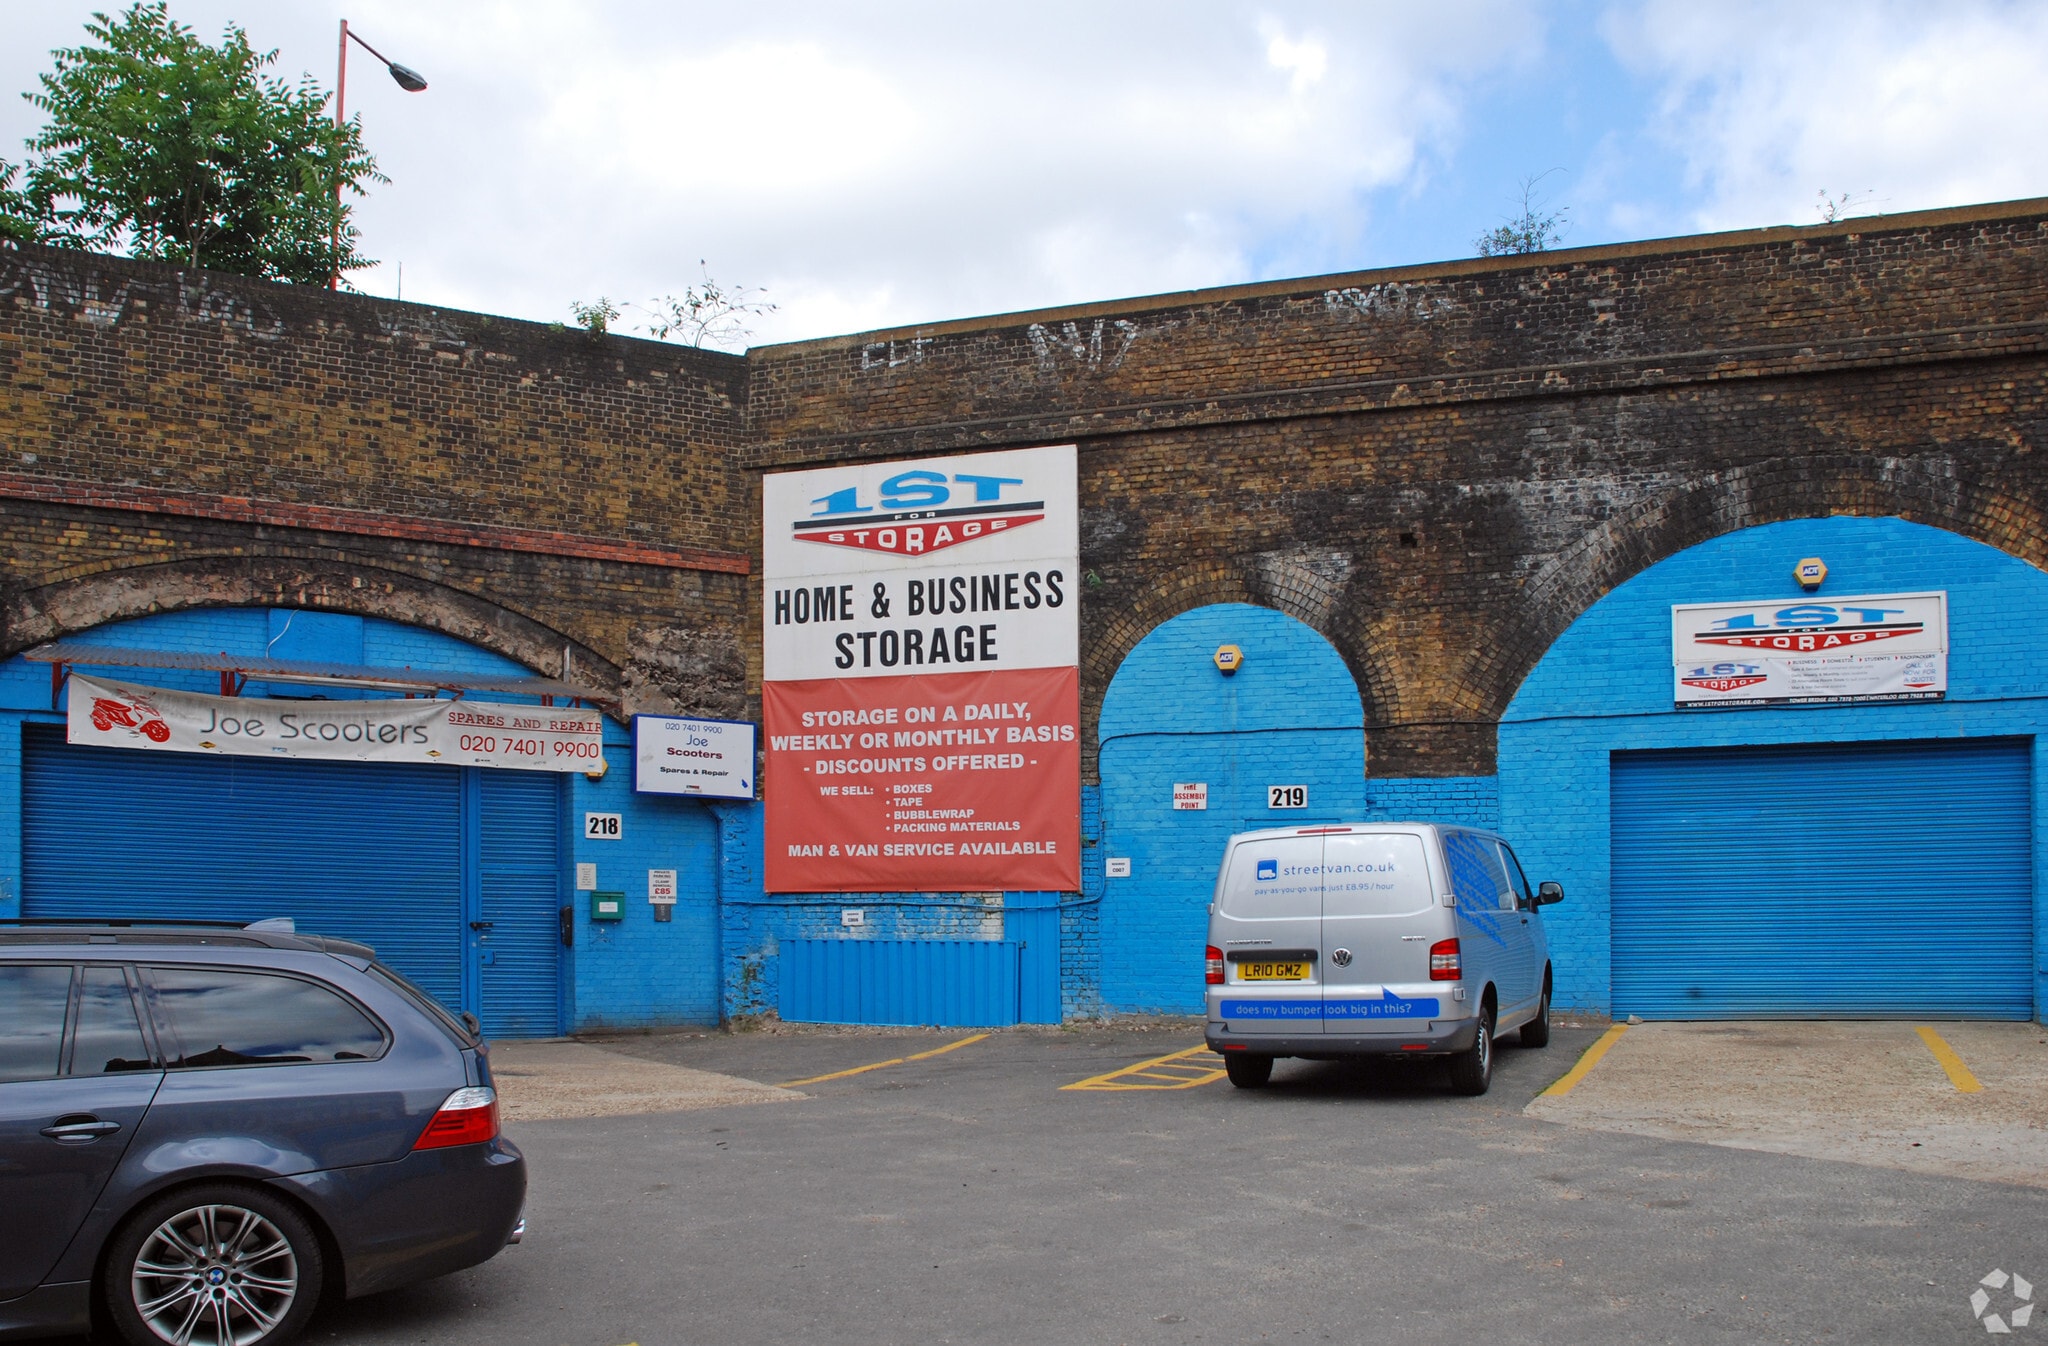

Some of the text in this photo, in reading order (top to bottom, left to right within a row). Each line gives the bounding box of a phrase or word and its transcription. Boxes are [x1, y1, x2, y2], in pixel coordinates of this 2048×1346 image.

[810, 470, 1024, 517] 1ST
[894, 511, 937, 521] FOR
[828, 519, 1008, 552] STORAGE
[1803, 566, 1819, 575] ADT
[774, 570, 1064, 625] HOME & BUSINESS
[1711, 605, 1904, 631] 1ST
[834, 624, 998, 669] STORAGE
[1727, 631, 1891, 651] STORAGE
[1687, 663, 1760, 677] 1ST
[1692, 679, 1756, 690] STORAGE
[448, 711, 505, 727] SPARES
[512, 718, 541, 729] AND
[801, 702, 1032, 728] STORAGE ON A DAILY,
[200, 708, 429, 744] Joe Scooters
[665, 722, 723, 734] 020 7401 9900
[686, 734, 709, 747] Joe
[770, 724, 1075, 752] WEEKLY OR MONTHLY BASIS
[460, 734, 599, 759] 020 7401 9900
[666, 747, 723, 760] Scooters
[660, 766, 690, 775] Spares
[692, 767, 699, 775] &
[815, 756, 927, 775] DISCOUNTS
[932, 753, 1025, 772] OFFERED
[820, 785, 875, 796] WE SELL:
[893, 784, 933, 795] BOXES
[1174, 792, 1206, 800] ASSEMBLY
[893, 797, 923, 807] TAPE
[1271, 787, 1304, 807] 219
[893, 809, 975, 821] BUBBLEWRAP
[589, 816, 619, 836] 218
[893, 821, 1021, 833] PACKING MATERIALS
[788, 841, 1056, 857] MAN & VAN SERVICE AVAILABLE
[1283, 862, 1395, 876] streetvan.co.uk
[654, 887, 671, 895] £85
[1254, 886, 1307, 896] pay-as-you-go
[1328, 885, 1344, 893] just
[1345, 883, 1370, 891] £8.95
[1375, 882, 1394, 890] hour
[1245, 963, 1302, 977] LR10 GMZ
[1236, 1003, 1412, 1017] does my bumper look big in this?
